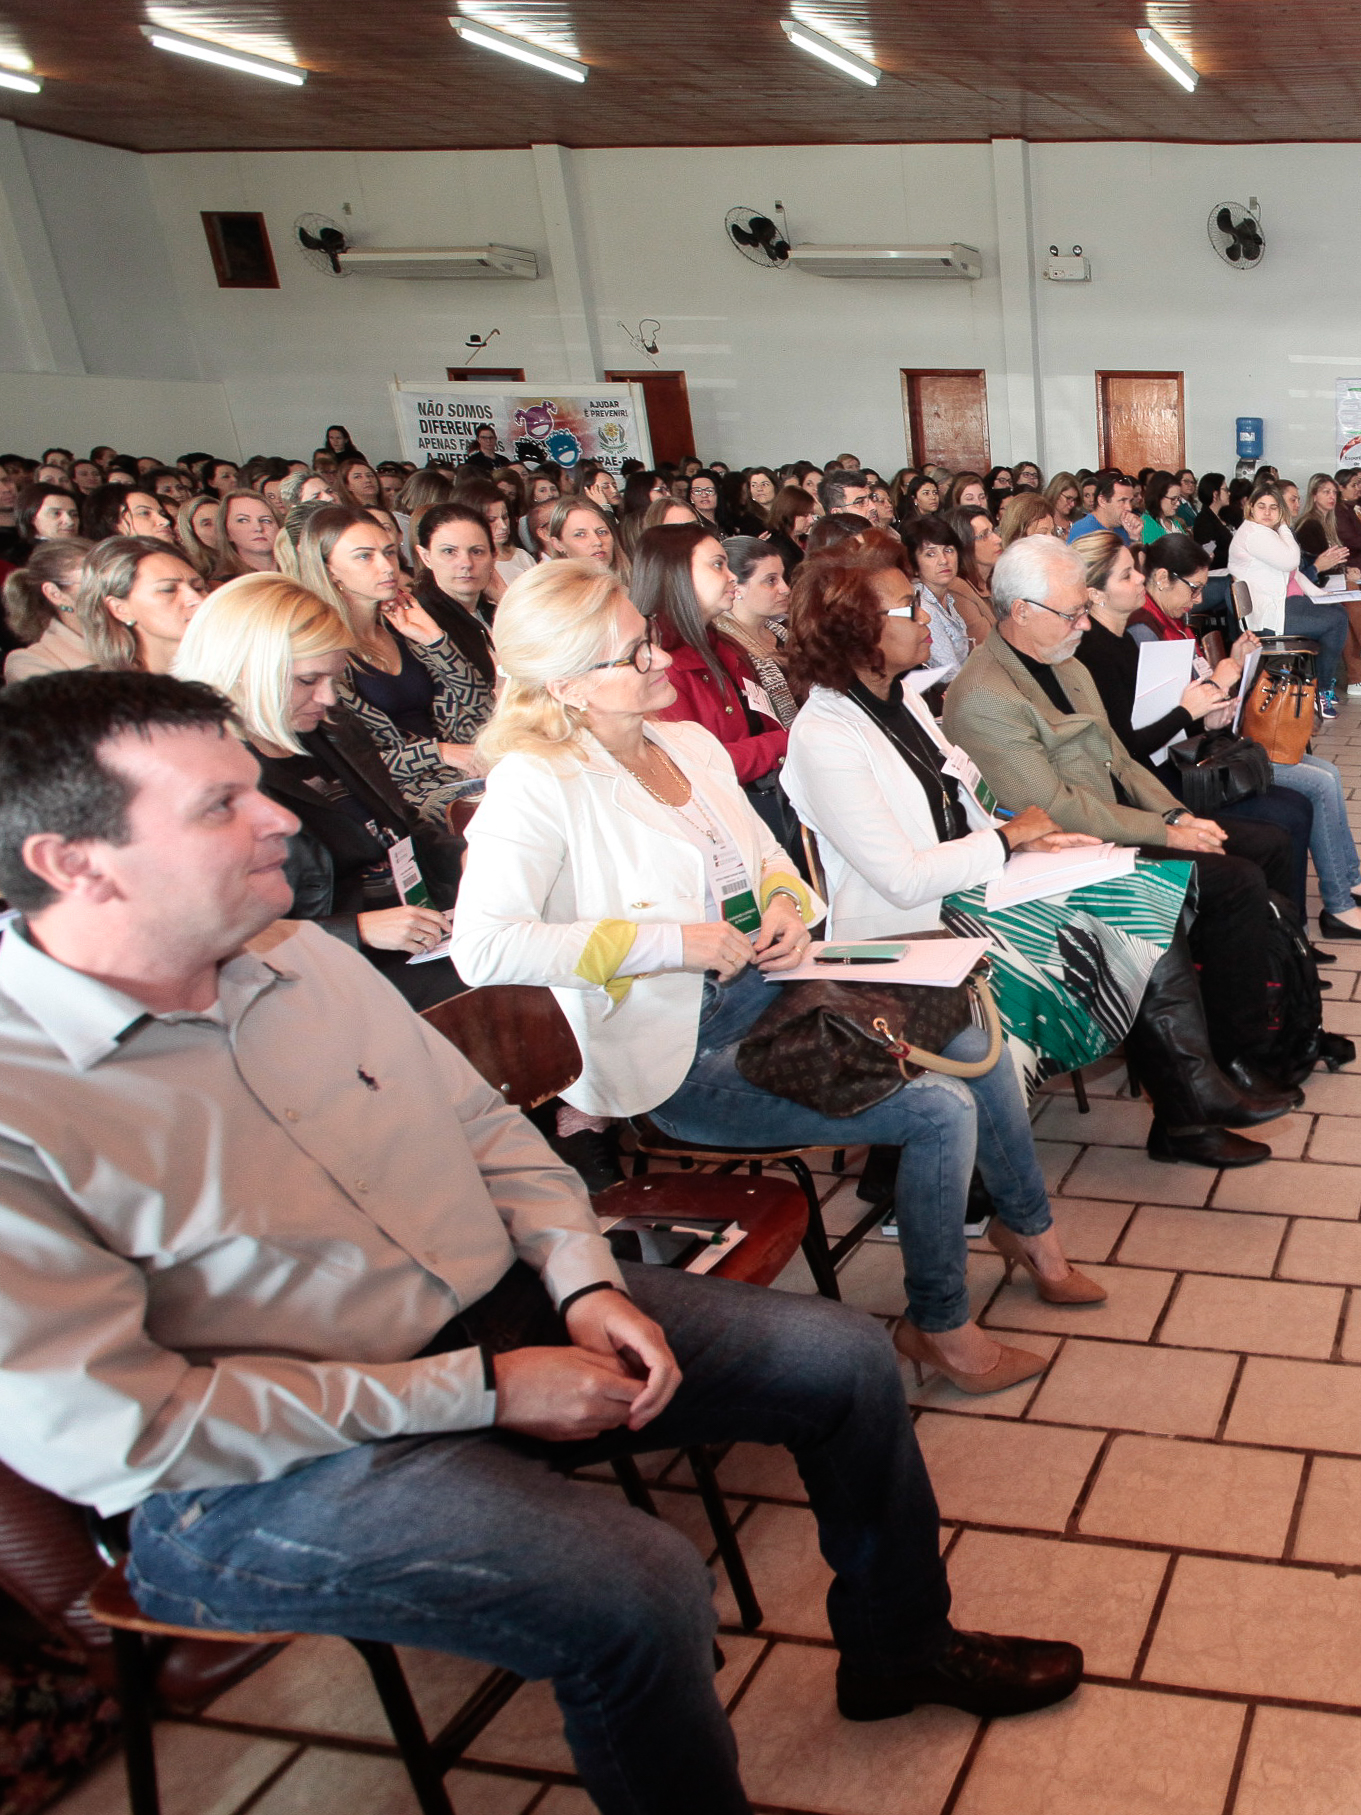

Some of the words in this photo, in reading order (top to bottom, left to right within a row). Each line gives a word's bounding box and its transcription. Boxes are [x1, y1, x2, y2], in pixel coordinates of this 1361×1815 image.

[417, 400, 444, 416] NÃO
[447, 403, 493, 419] SOMOS
[591, 409, 628, 417] PREVENIR!
[419, 420, 496, 436] DIFERENT
[418, 437, 457, 450] APENAS
